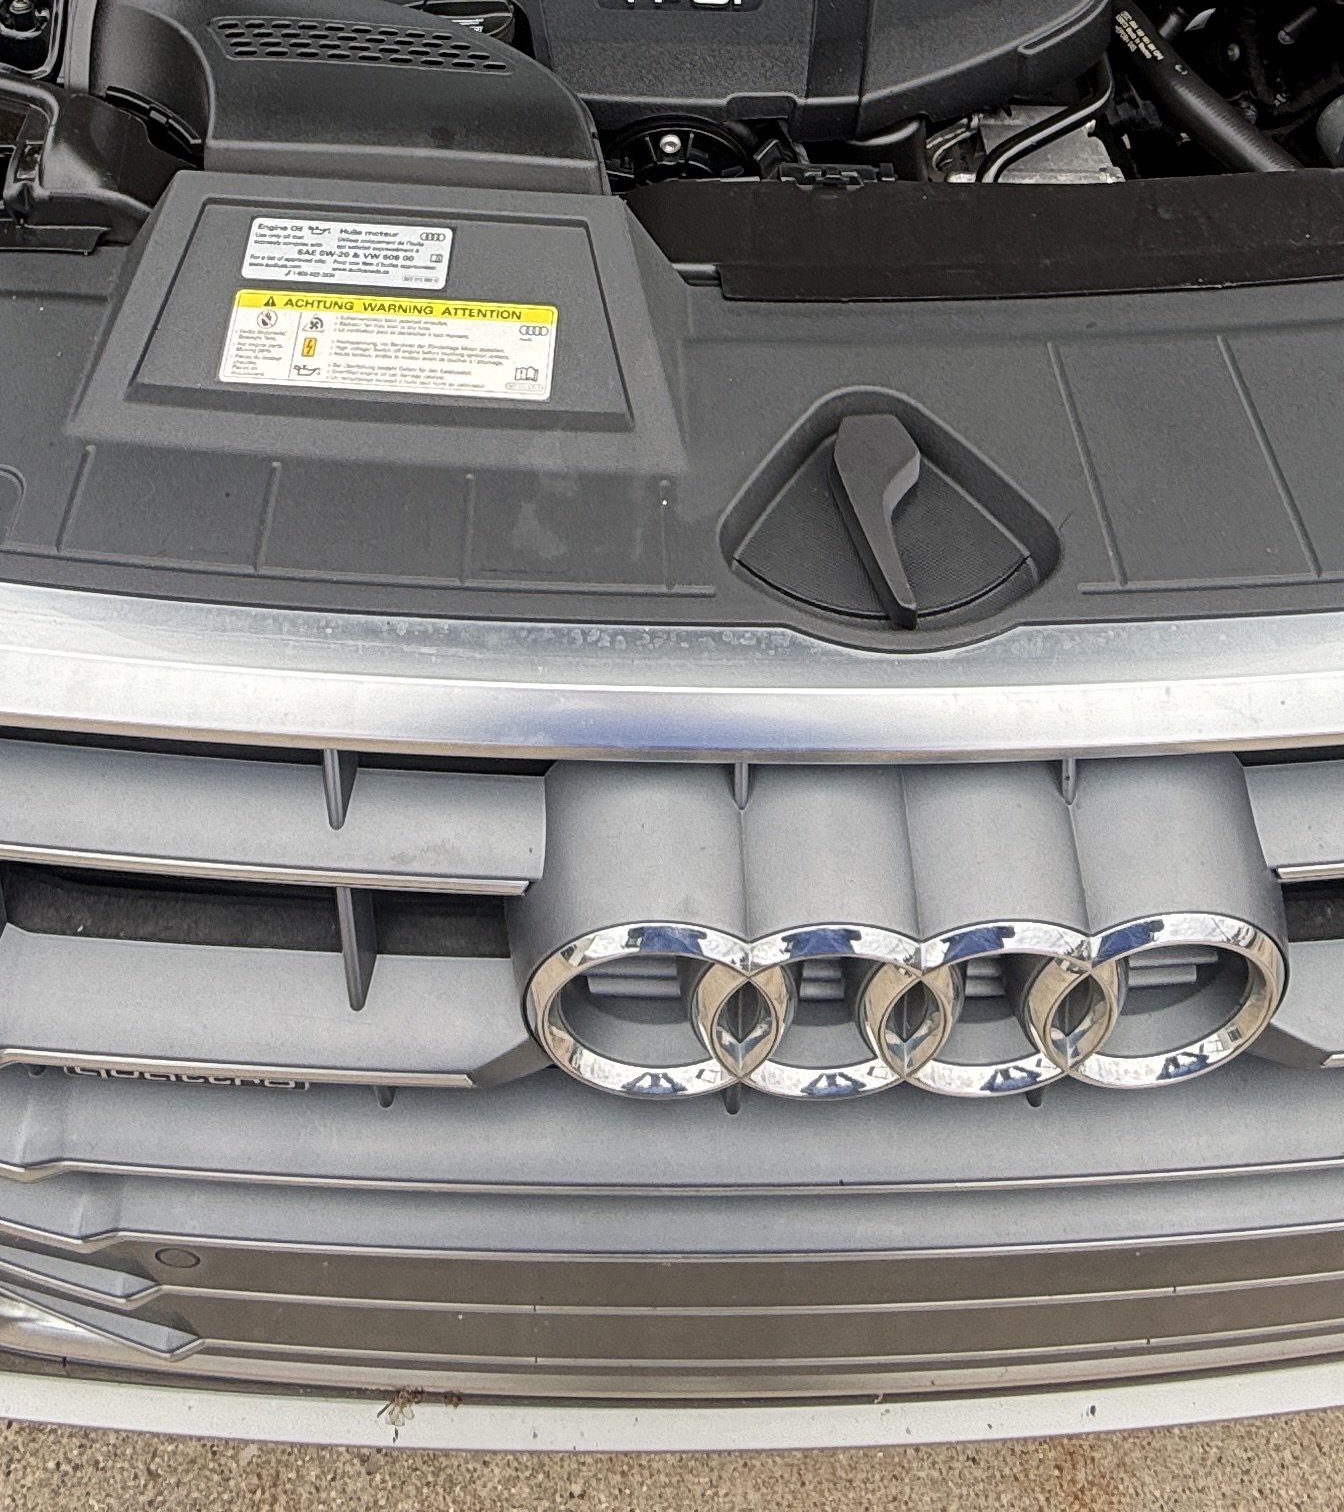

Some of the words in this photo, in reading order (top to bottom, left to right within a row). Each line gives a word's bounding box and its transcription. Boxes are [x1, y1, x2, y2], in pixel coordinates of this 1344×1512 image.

[258, 223, 288, 232] Engine
[340, 228, 363, 236] Huile
[319, 250, 350, 258] 0W-20
[283, 298, 354, 311] ACHTUNG
[363, 302, 434, 315] WARNING
[441, 307, 522, 320] ATTENTION
